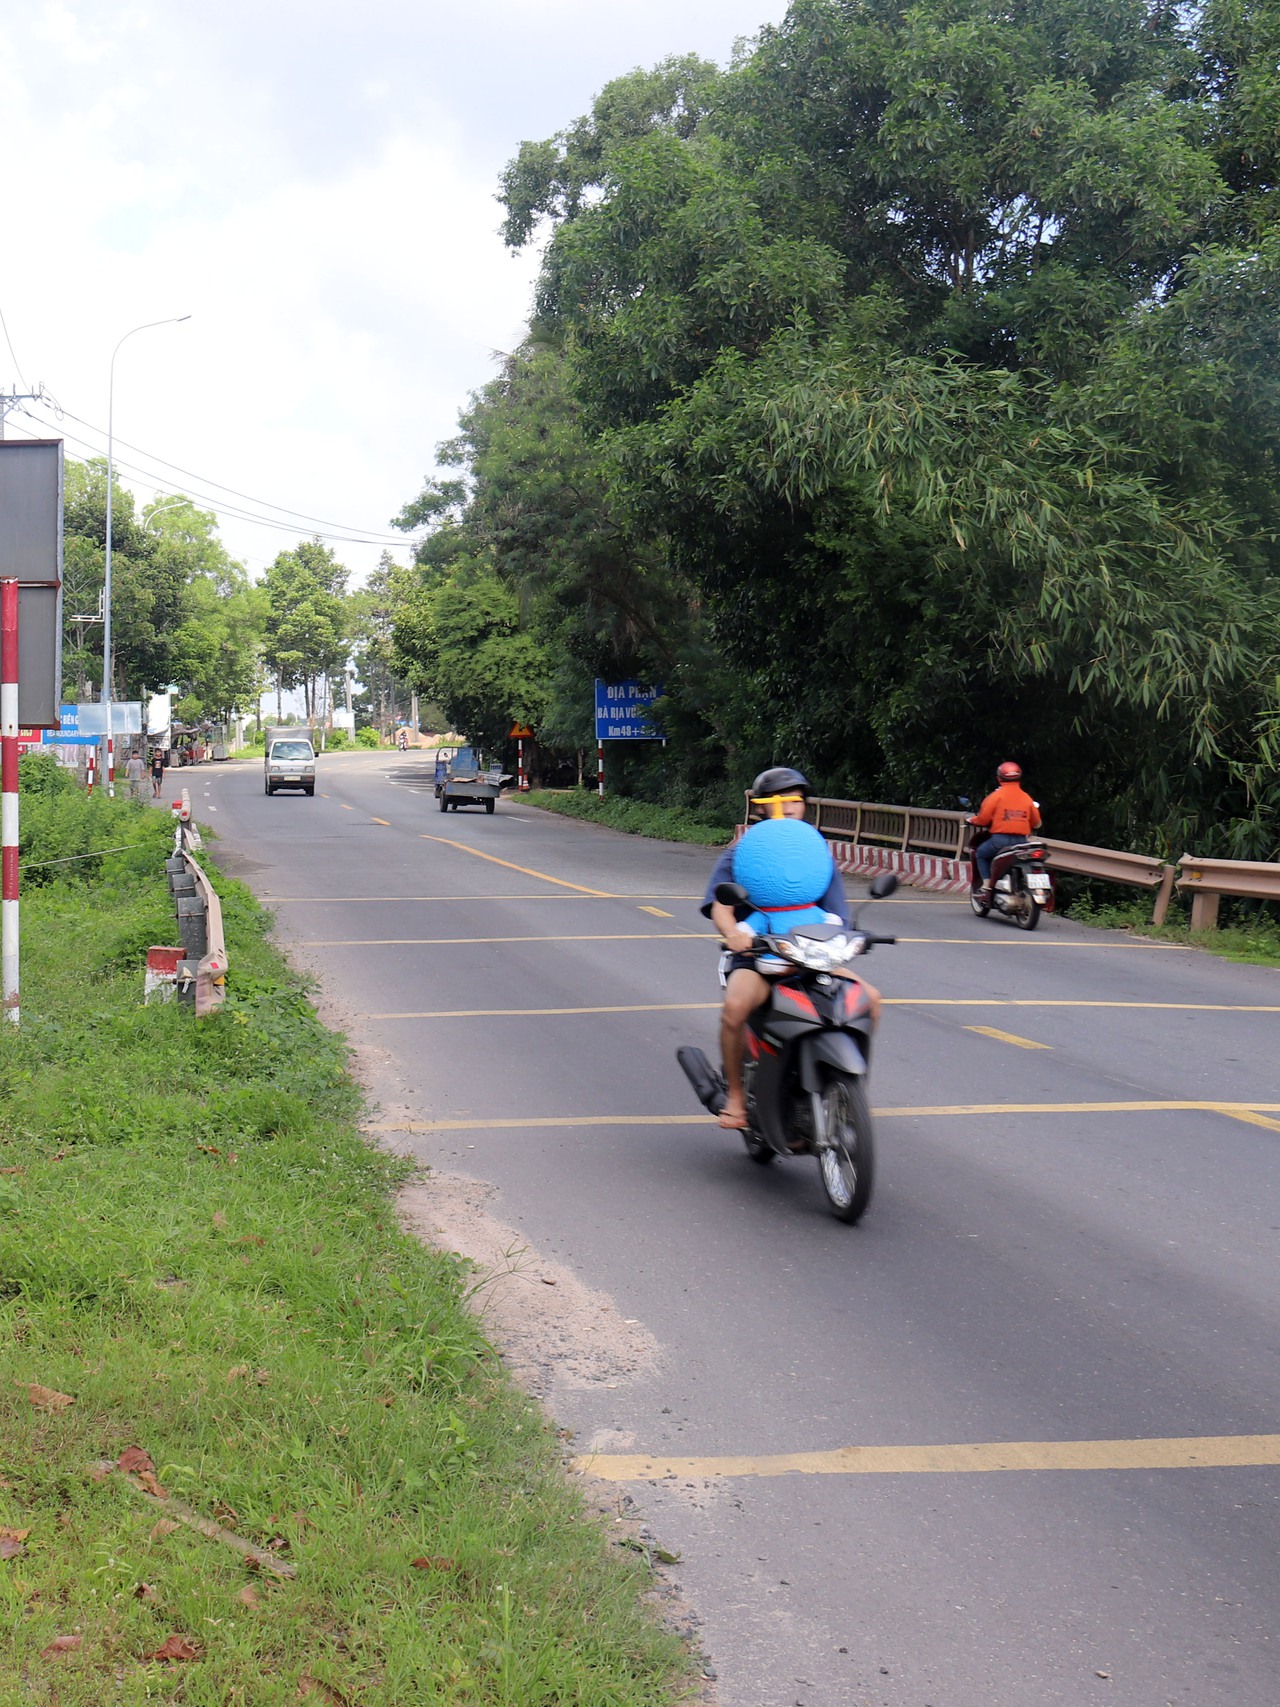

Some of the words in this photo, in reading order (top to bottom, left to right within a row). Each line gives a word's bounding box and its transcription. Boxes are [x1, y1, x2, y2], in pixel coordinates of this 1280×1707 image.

[607, 686, 625, 701] ĐỊA
[597, 705, 609, 719] BÀ
[610, 707, 624, 720] RỊA
